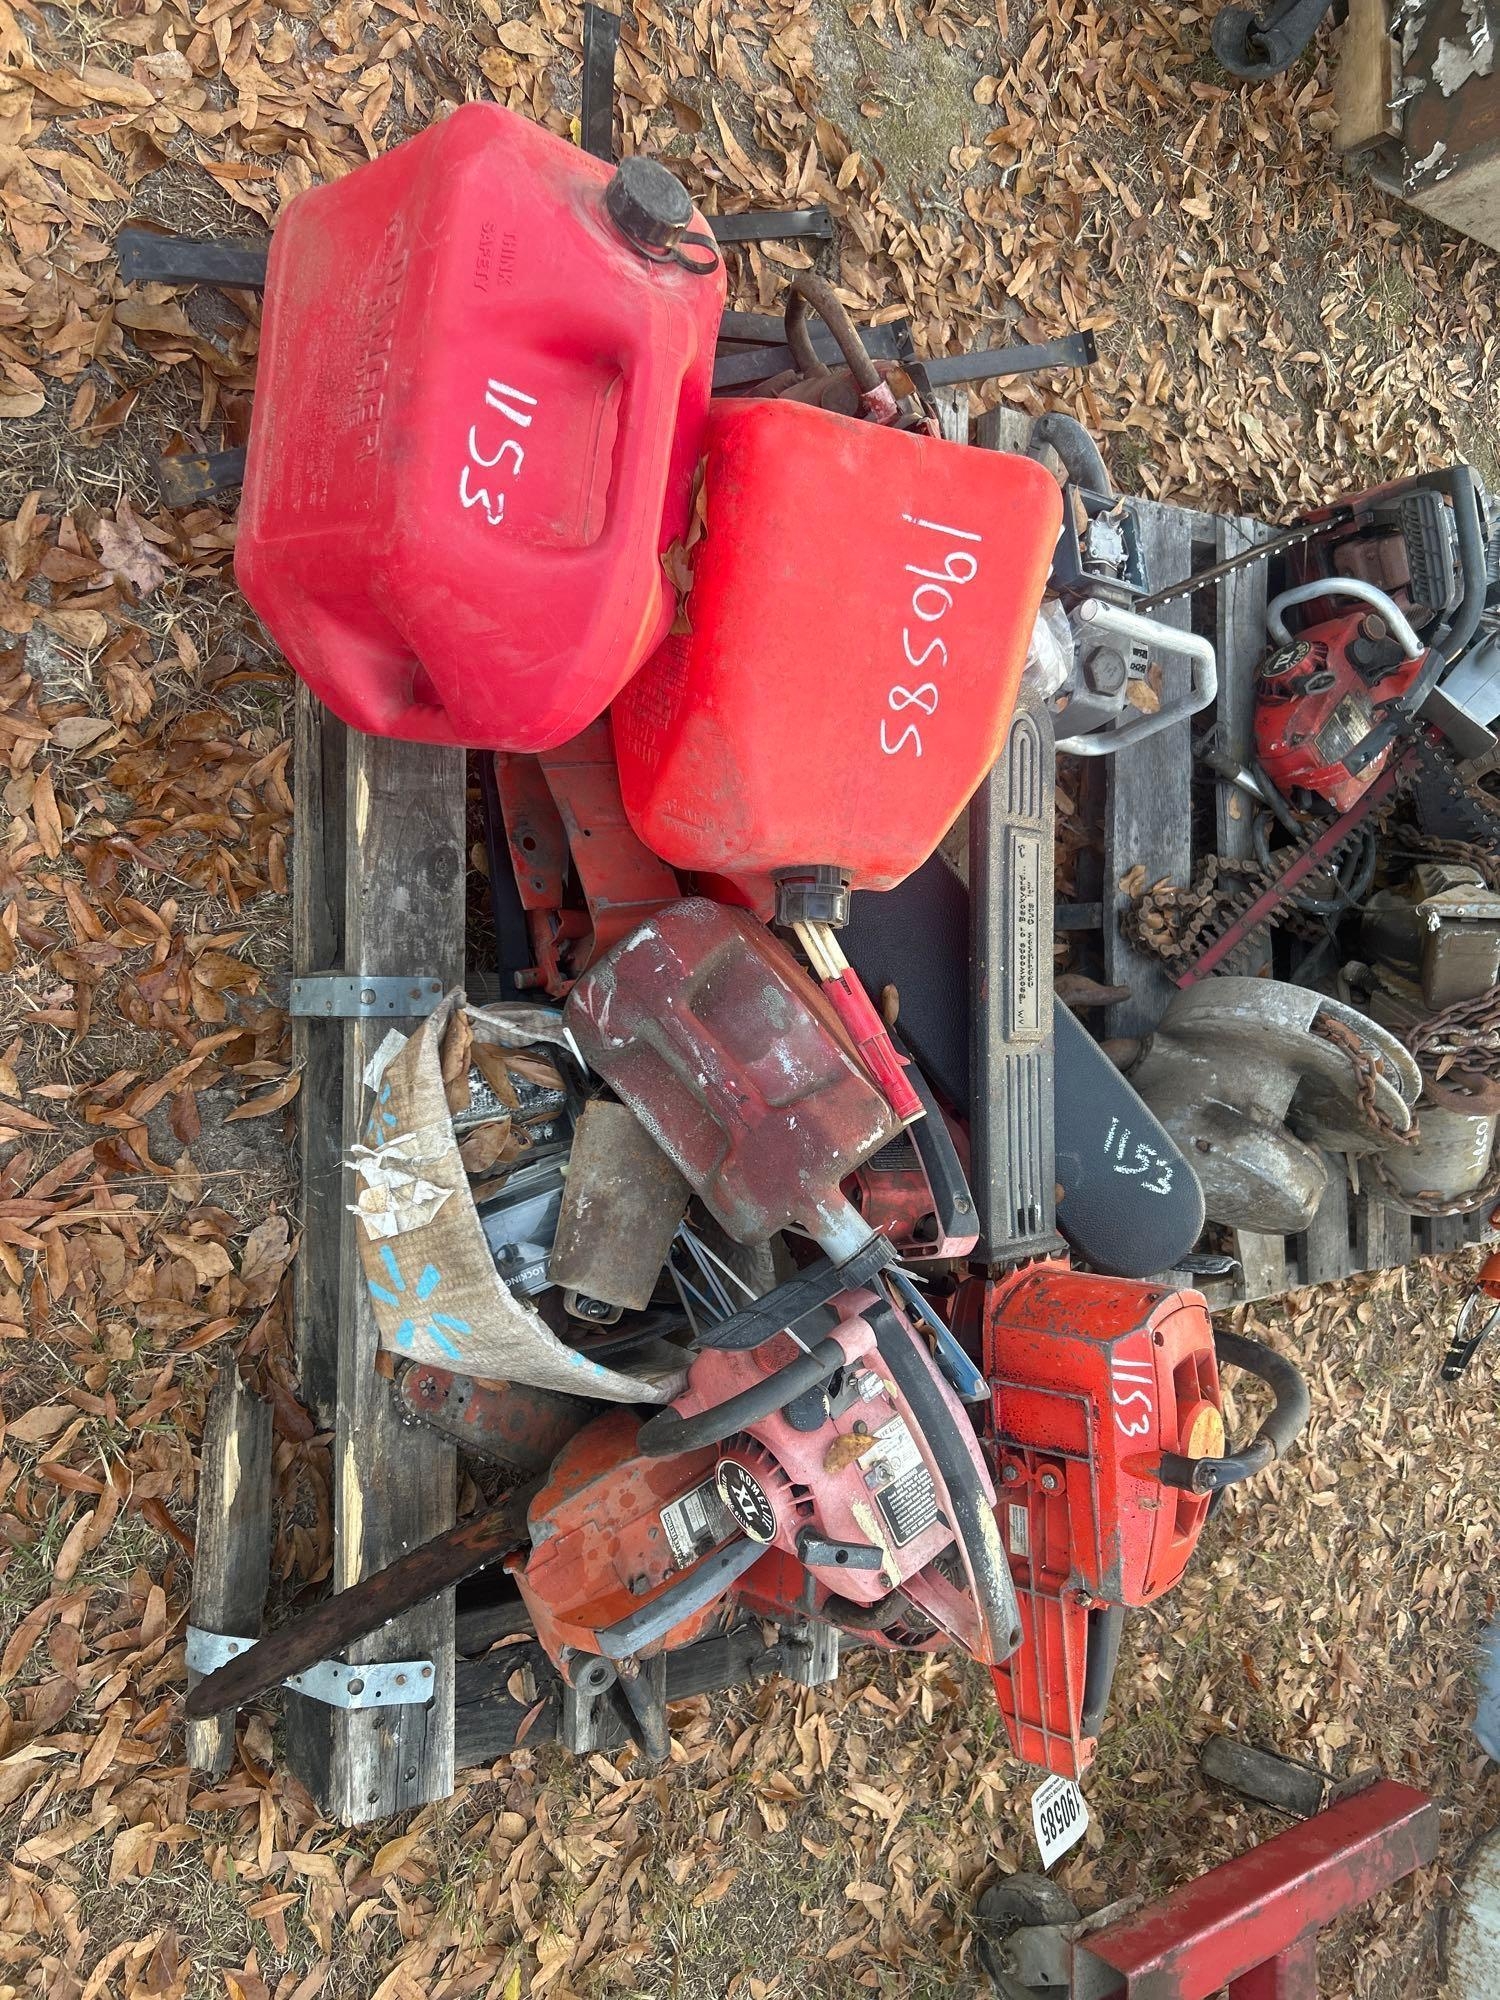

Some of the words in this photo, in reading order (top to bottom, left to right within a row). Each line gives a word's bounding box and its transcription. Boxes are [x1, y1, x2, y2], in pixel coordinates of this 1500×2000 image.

[474, 220, 497, 293] SAFETY
[497, 232, 517, 288] THINK
[460, 379, 537, 525] 1153
[880, 513, 983, 757] 190585
[1104, 1116, 1173, 1194] 1153
[1111, 1355, 1152, 1437] 1153
[731, 1486, 760, 1521] XL
[738, 1468, 773, 1532] HOMELITE
[1041, 1782, 1081, 1846] 190585
